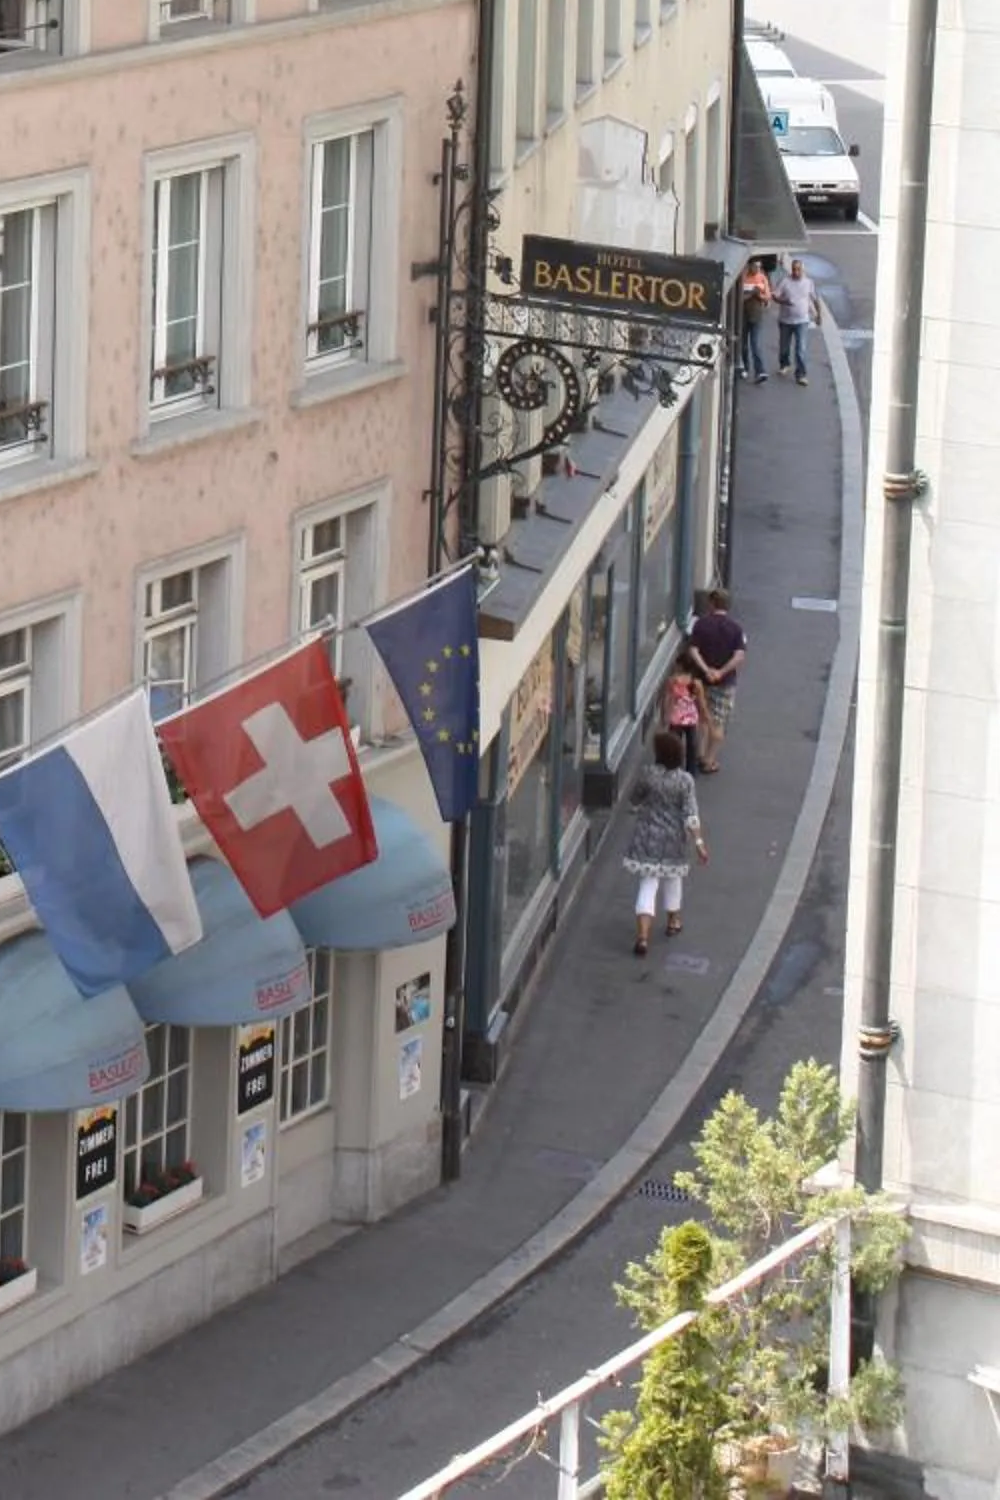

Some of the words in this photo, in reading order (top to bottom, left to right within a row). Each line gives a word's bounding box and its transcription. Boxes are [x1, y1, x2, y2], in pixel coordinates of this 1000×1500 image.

[596, 251, 645, 271] HOTEL
[534, 260, 707, 311] BASLERTOR
[245, 1074, 267, 1098] FREI
[79, 1124, 114, 1156] ZIMMER
[85, 1158, 108, 1182] FREI
